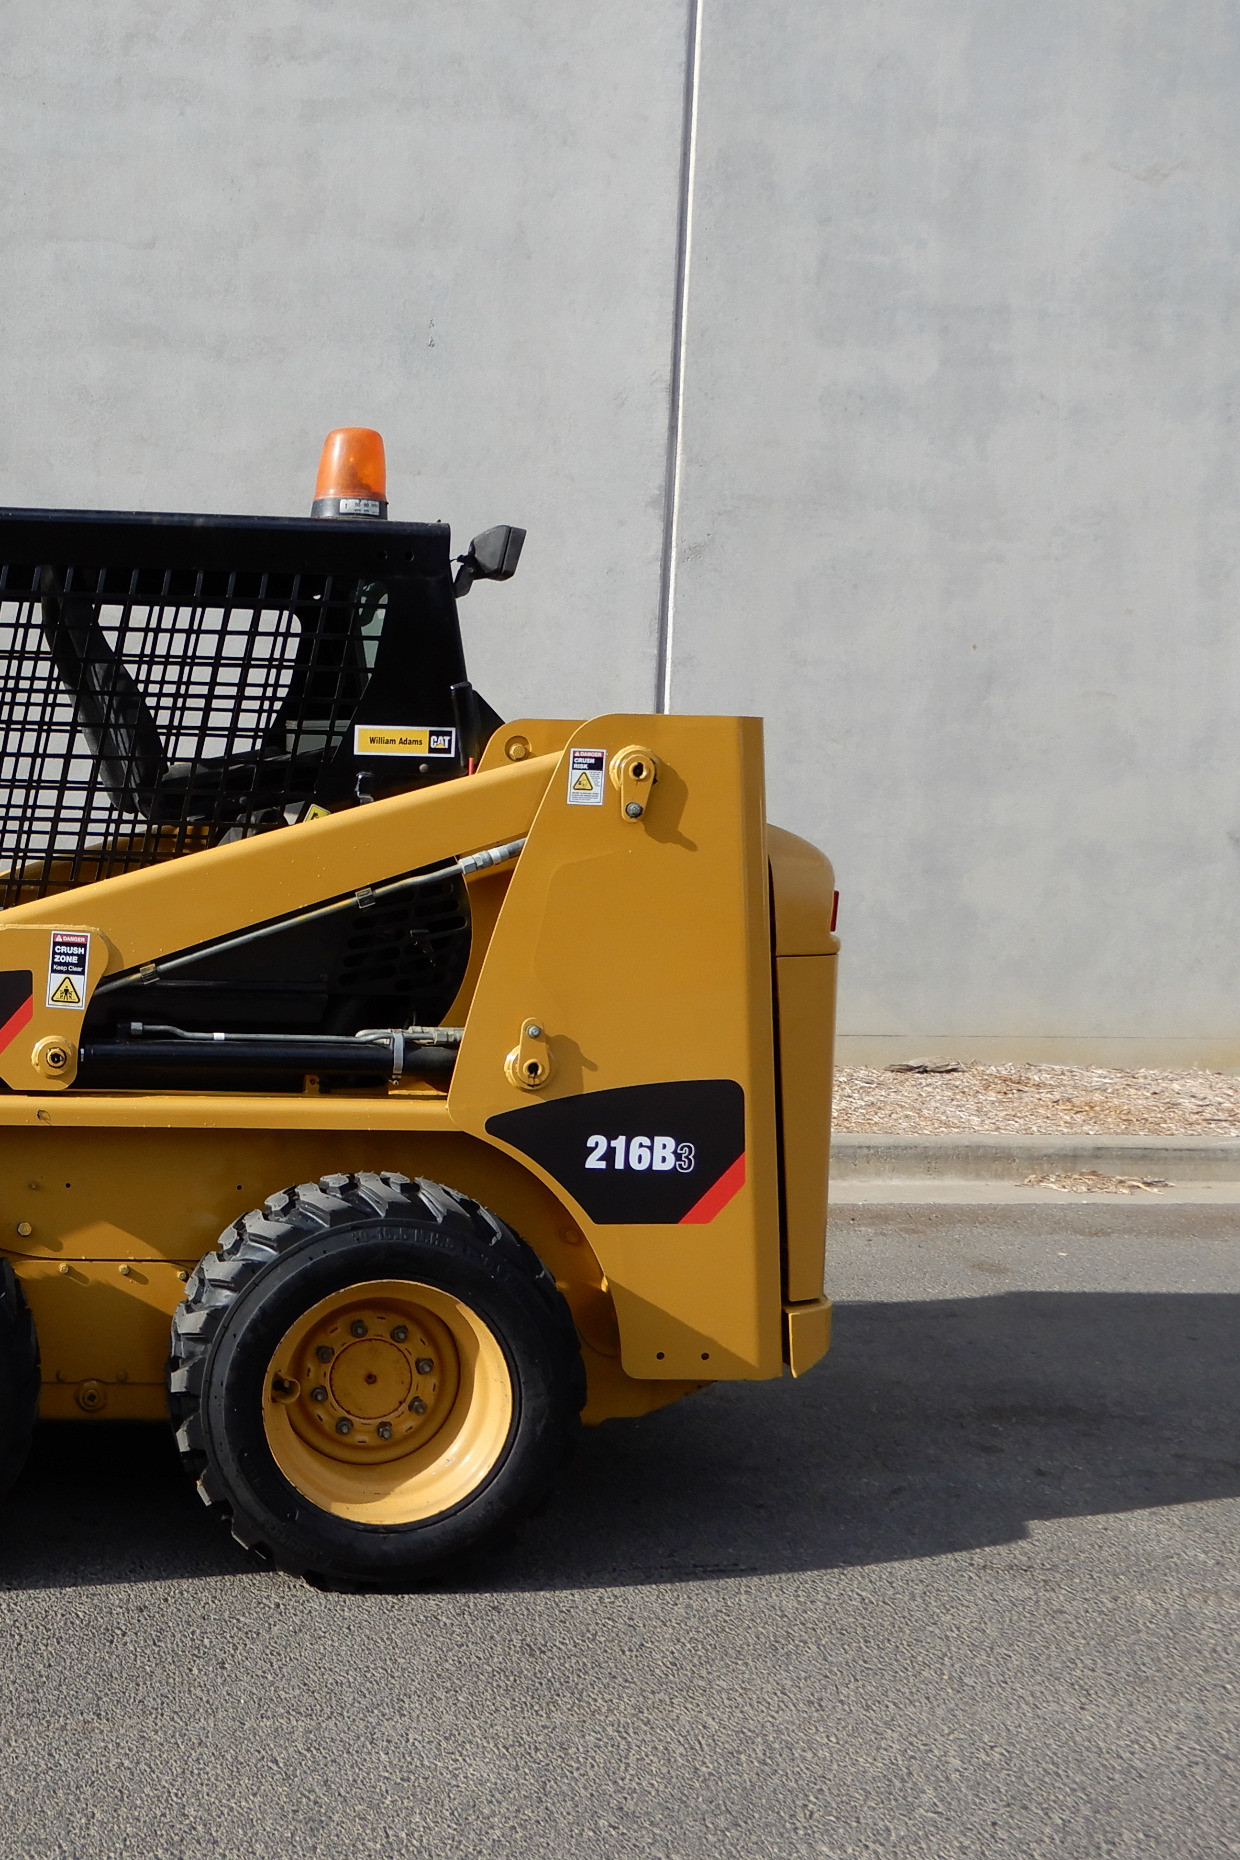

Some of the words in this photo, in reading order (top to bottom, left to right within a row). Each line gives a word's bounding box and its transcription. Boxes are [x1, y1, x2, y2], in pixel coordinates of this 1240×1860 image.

[369, 736, 397, 745] William
[398, 737, 423, 746] Adams
[430, 735, 451, 749] CAT
[54, 946, 85, 954] CRUSH
[54, 955, 78, 963] ZONE
